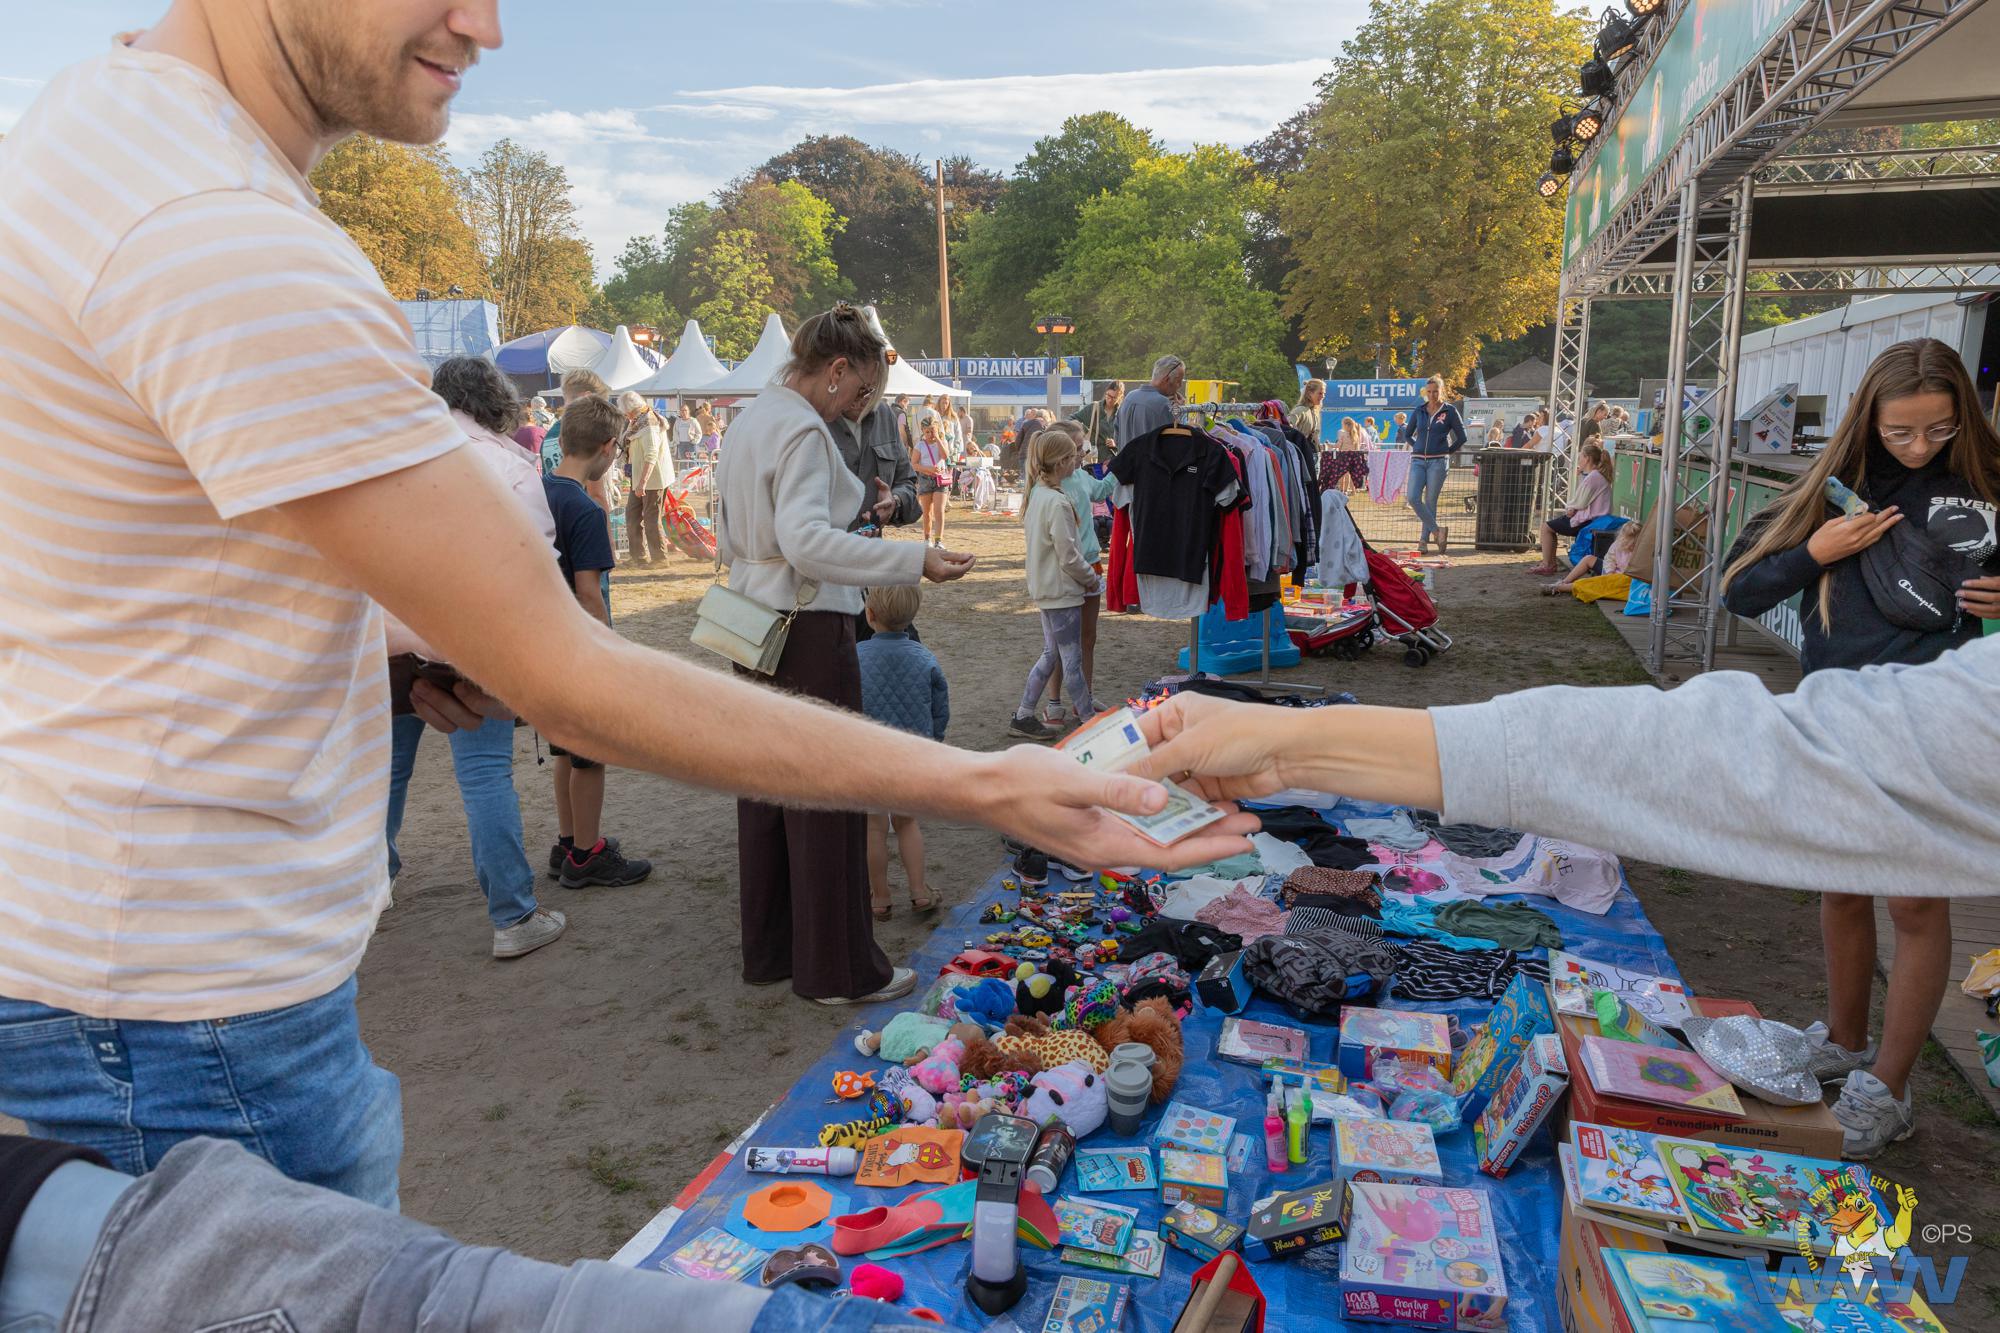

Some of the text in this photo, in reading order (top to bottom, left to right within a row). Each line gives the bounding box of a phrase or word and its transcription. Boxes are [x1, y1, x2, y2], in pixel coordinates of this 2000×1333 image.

[967, 360, 1045, 376] DRANKEN
[1338, 383, 1416, 398] TOILETTEN
[1931, 497, 1998, 512] SEVEN
[1898, 579, 1942, 617] Champion
[1076, 750, 1093, 765] 5
[1657, 1116, 1779, 1138] Cavendish Bananas
[1490, 1141, 1517, 1175] REISSPEL
[1394, 1298, 1429, 1311] Creative
[1413, 1310, 1426, 1320] Kit
